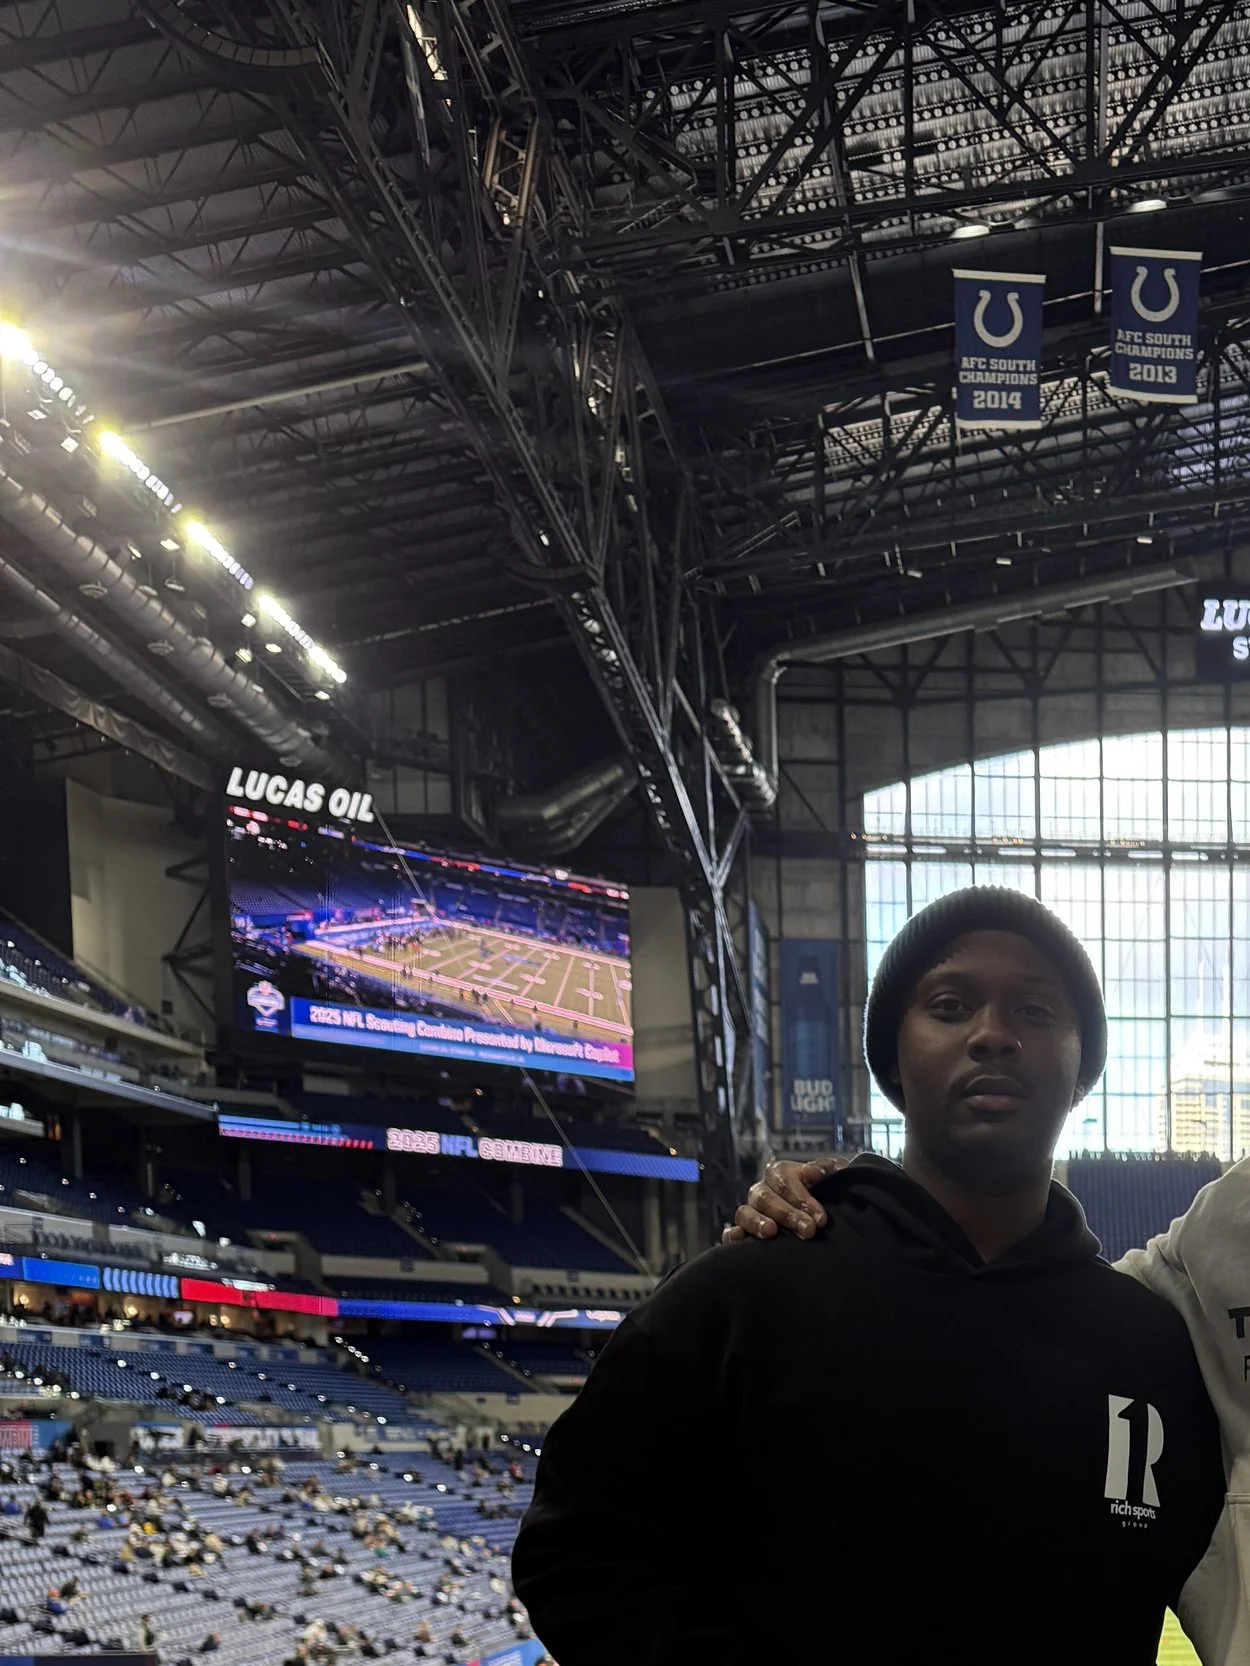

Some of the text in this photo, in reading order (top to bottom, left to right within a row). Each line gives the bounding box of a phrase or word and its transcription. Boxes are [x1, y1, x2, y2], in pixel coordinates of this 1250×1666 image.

[1117, 329, 1192, 346] AFC SOUTH
[1115, 342, 1194, 360] CHAMPIONS
[961, 357, 1036, 372] AFC SOUTH
[958, 370, 1039, 386] CHAMPIONS
[1129, 364, 1178, 384] 2013
[973, 390, 1022, 409] 2014
[226, 767, 375, 823] LUCAS OIL
[309, 1005, 342, 1026] 2025
[343, 1010, 365, 1029] NFL
[366, 1012, 416, 1039] Scouting
[416, 1019, 463, 1042] Combine
[464, 1027, 520, 1050] Presented
[520, 1034, 533, 1054] by
[534, 1036, 583, 1059] Microsoft
[584, 1043, 620, 1064] Copilot
[793, 1079, 833, 1097] BUD
[790, 1095, 836, 1113] LIGHT
[386, 1127, 564, 1167] 2025 NFL COMBINE
[1110, 1500, 1156, 1520] rich sports
